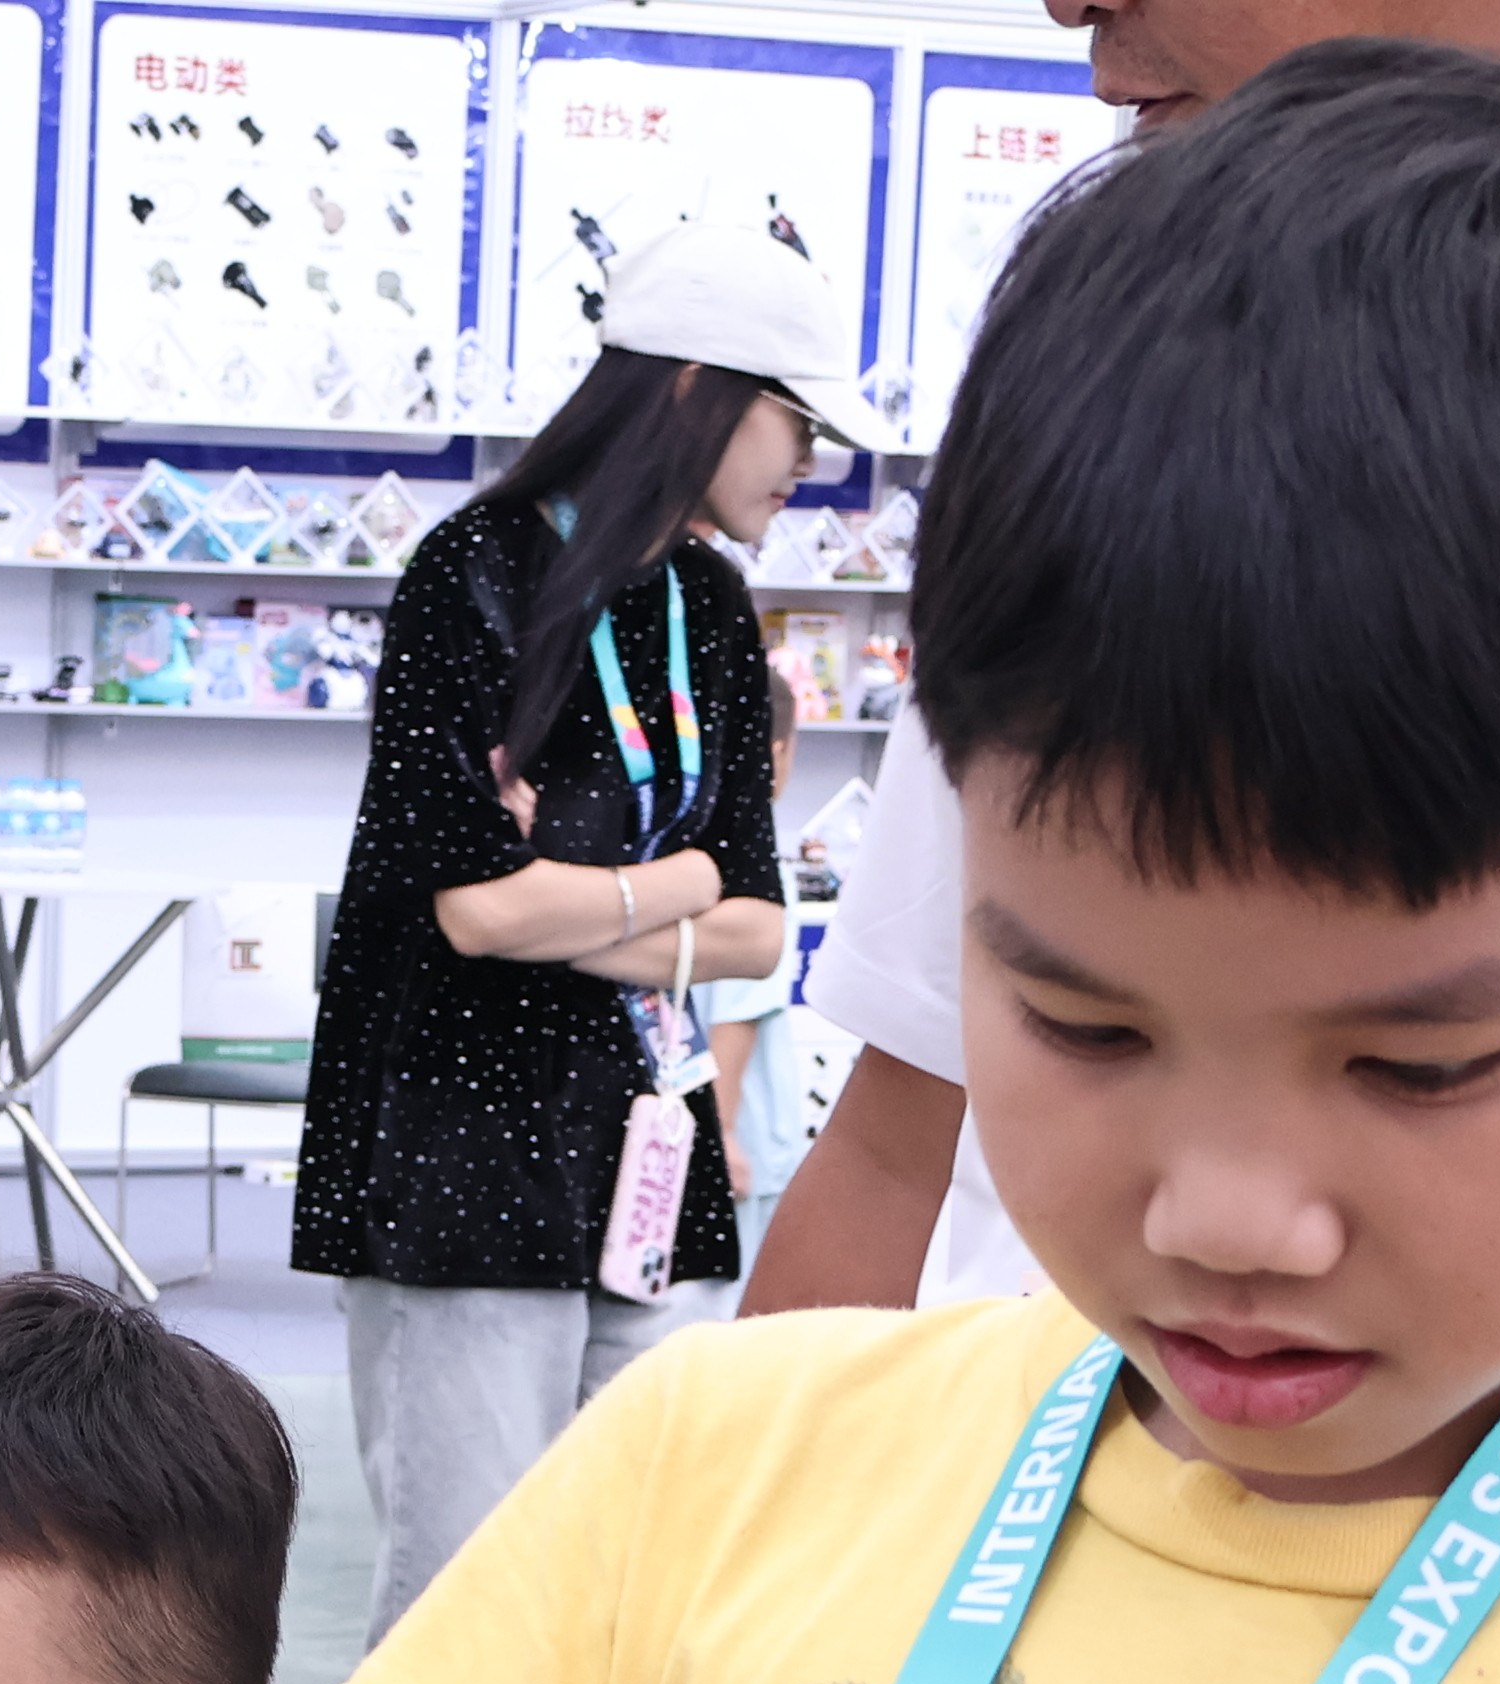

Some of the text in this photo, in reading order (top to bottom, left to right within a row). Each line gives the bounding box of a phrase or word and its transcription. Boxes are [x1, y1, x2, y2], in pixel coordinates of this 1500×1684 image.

[135, 53, 247, 97] 电动类
[947, 1333, 1119, 1625] INTERNAT
